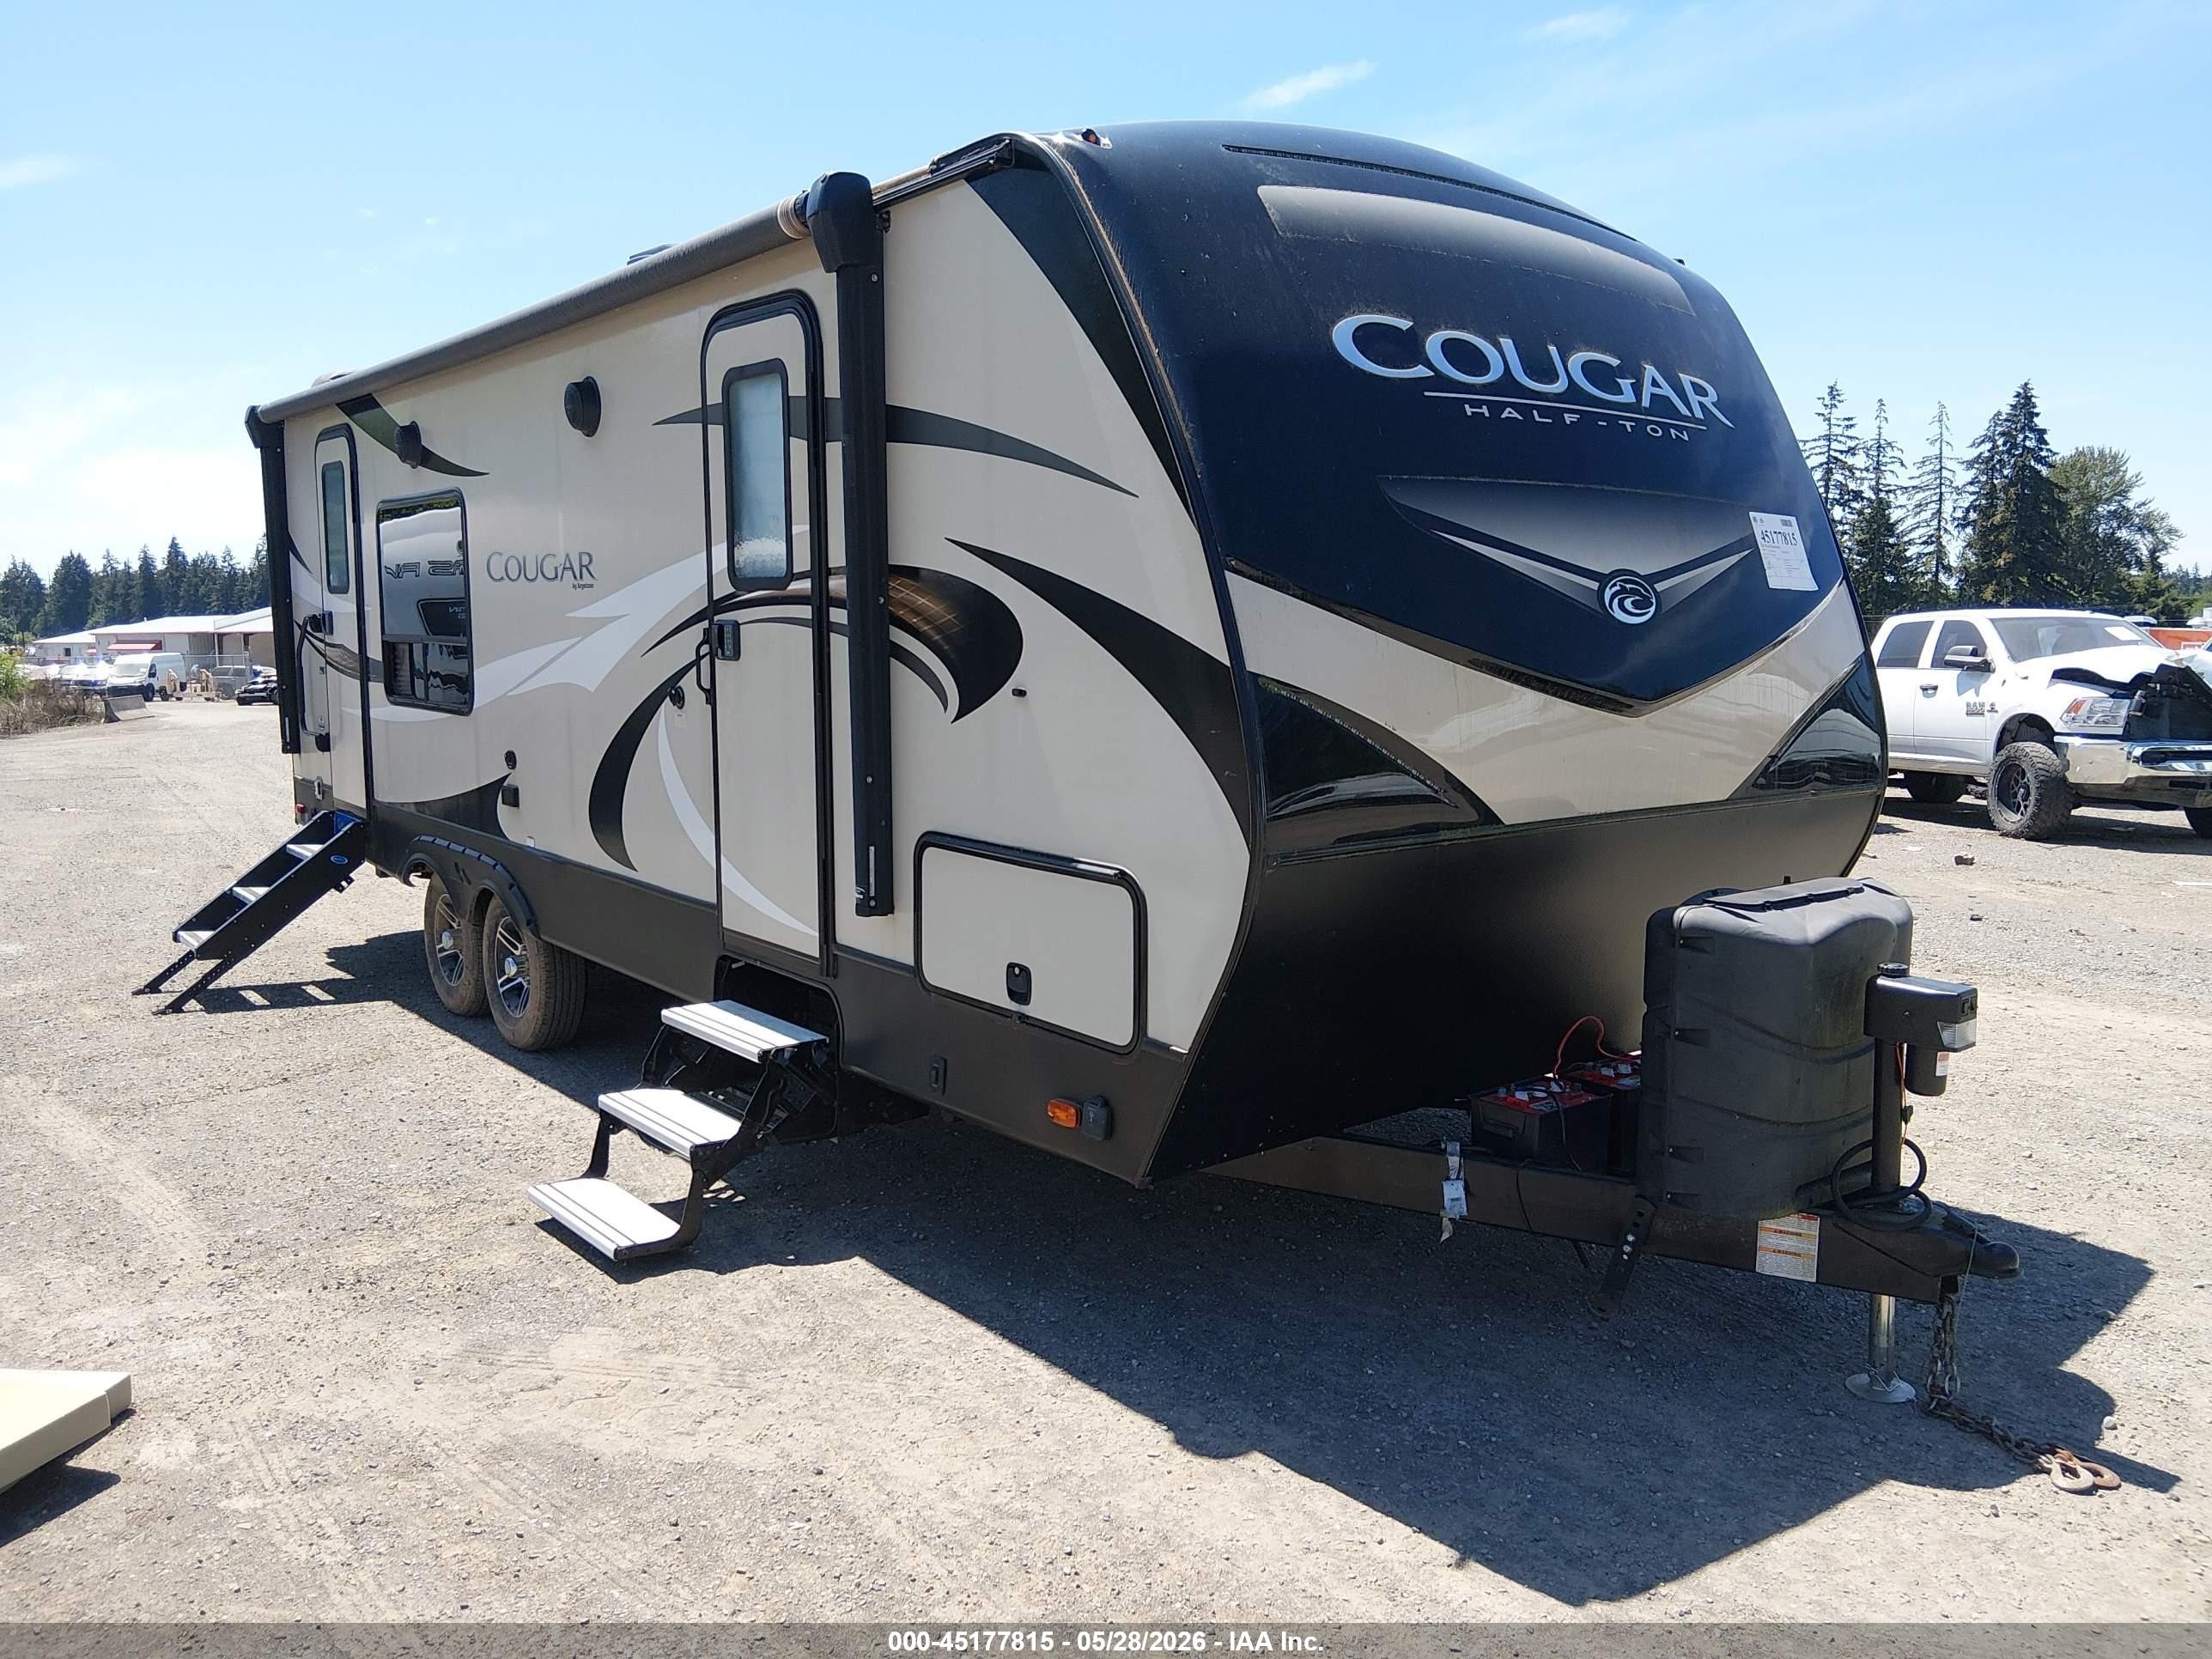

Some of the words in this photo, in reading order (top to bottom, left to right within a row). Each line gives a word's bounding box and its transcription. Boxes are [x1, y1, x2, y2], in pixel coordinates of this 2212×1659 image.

[1332, 314, 1735, 428] COUGAR
[1464, 404, 1689, 441] HALF-TON
[1760, 530, 1797, 546] 45177815
[486, 551, 598, 582] COUGAR
